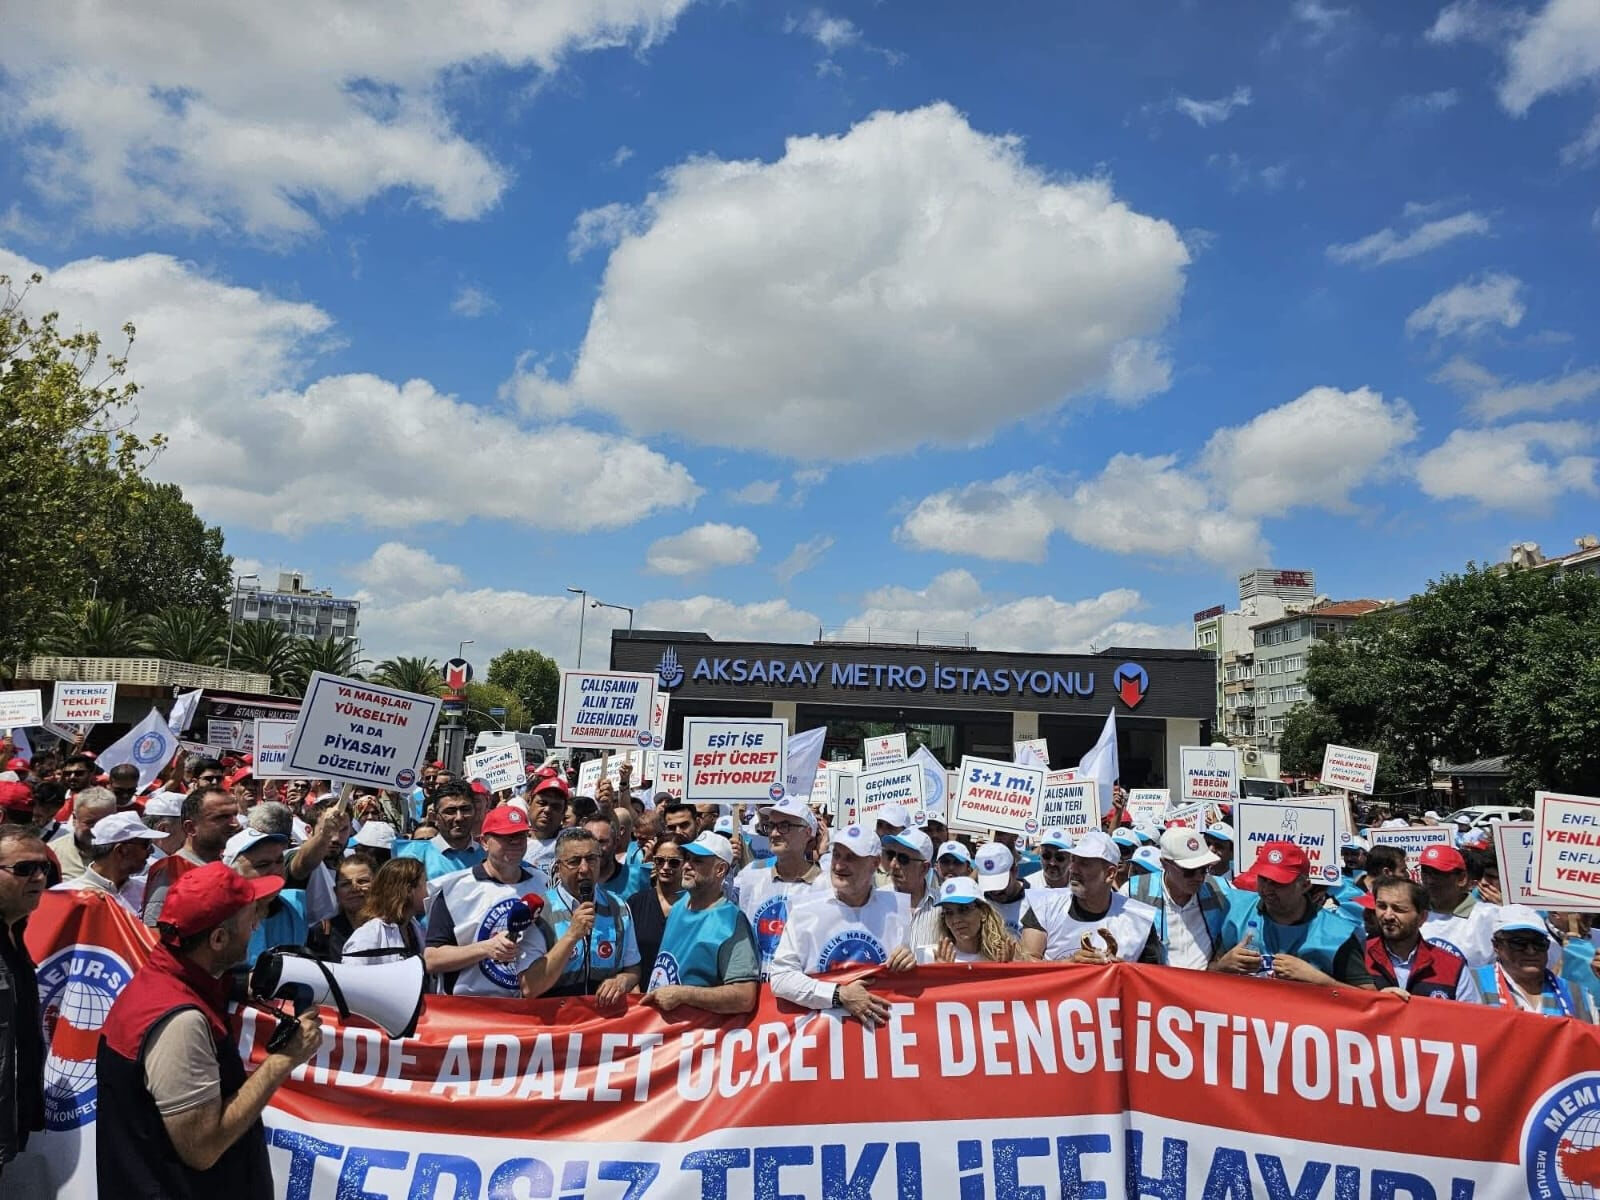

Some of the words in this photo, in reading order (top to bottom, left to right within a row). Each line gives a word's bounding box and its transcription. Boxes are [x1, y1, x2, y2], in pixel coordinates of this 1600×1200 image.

[692, 657, 824, 684] AKSARAY
[831, 662, 927, 689] METRO
[934, 660, 1095, 695] İSTASYONU
[580, 678, 639, 694] ÇALIŞANIN
[62, 697, 107, 706] TEKLİFE
[338, 687, 352, 697] YA
[354, 691, 412, 711] MAAŞLARI
[582, 695, 609, 708] ALIN
[611, 696, 635, 710] TERİ
[67, 709, 100, 718] HAYIR
[335, 702, 408, 727] YÜKSELTİN
[576, 710, 638, 726] ÜZERİNDEN
[350, 723, 364, 734] YA
[367, 726, 383, 738] DA
[571, 727, 610, 737] TASARRUF
[610, 729, 639, 739] OLMAZ!
[324, 734, 396, 759] PİYASAYI
[708, 731, 739, 748] EŞİT
[741, 731, 764, 748] İŞE
[260, 750, 286, 762] BİLİM
[693, 750, 727, 768] EŞİT
[729, 750, 778, 765] ÜCRET
[318, 754, 391, 777] DÜZELTİN!
[1188, 769, 1215, 777] ANALIK
[1216, 769, 1231, 778] İZNİ
[695, 769, 776, 785] İSTİYORUZ!
[865, 773, 912, 791] GEÇİNMEK
[969, 768, 1002, 787] 3+1
[1006, 775, 1035, 795] mi,
[1192, 778, 1229, 788] BEBEĞİN
[968, 787, 1032, 806] AYRILIĞIN
[961, 800, 1008, 815] FORMULÜ
[1009, 808, 1033, 819] MÜ?
[1044, 802, 1062, 813] ALIN
[1041, 813, 1087, 827] ÜZERİNDEN
[1562, 813, 1600, 826] ENFL
[1299, 833, 1325, 846] İZNİ
[1376, 835, 1393, 843] AİLE
[1394, 834, 1421, 843] DOSTU
[1421, 834, 1446, 842] VERGİ
[818, 935, 843, 965] BİRLİK
[430, 1032, 664, 1102] ADALET
[677, 1002, 920, 1102] ÜCRETTE
[935, 997, 1124, 1077] DENGE
[1135, 1001, 1482, 1123] İSTİYORUZ!
[1543, 1086, 1600, 1133] MEM
[1536, 1150, 1552, 1199] MEMUR
